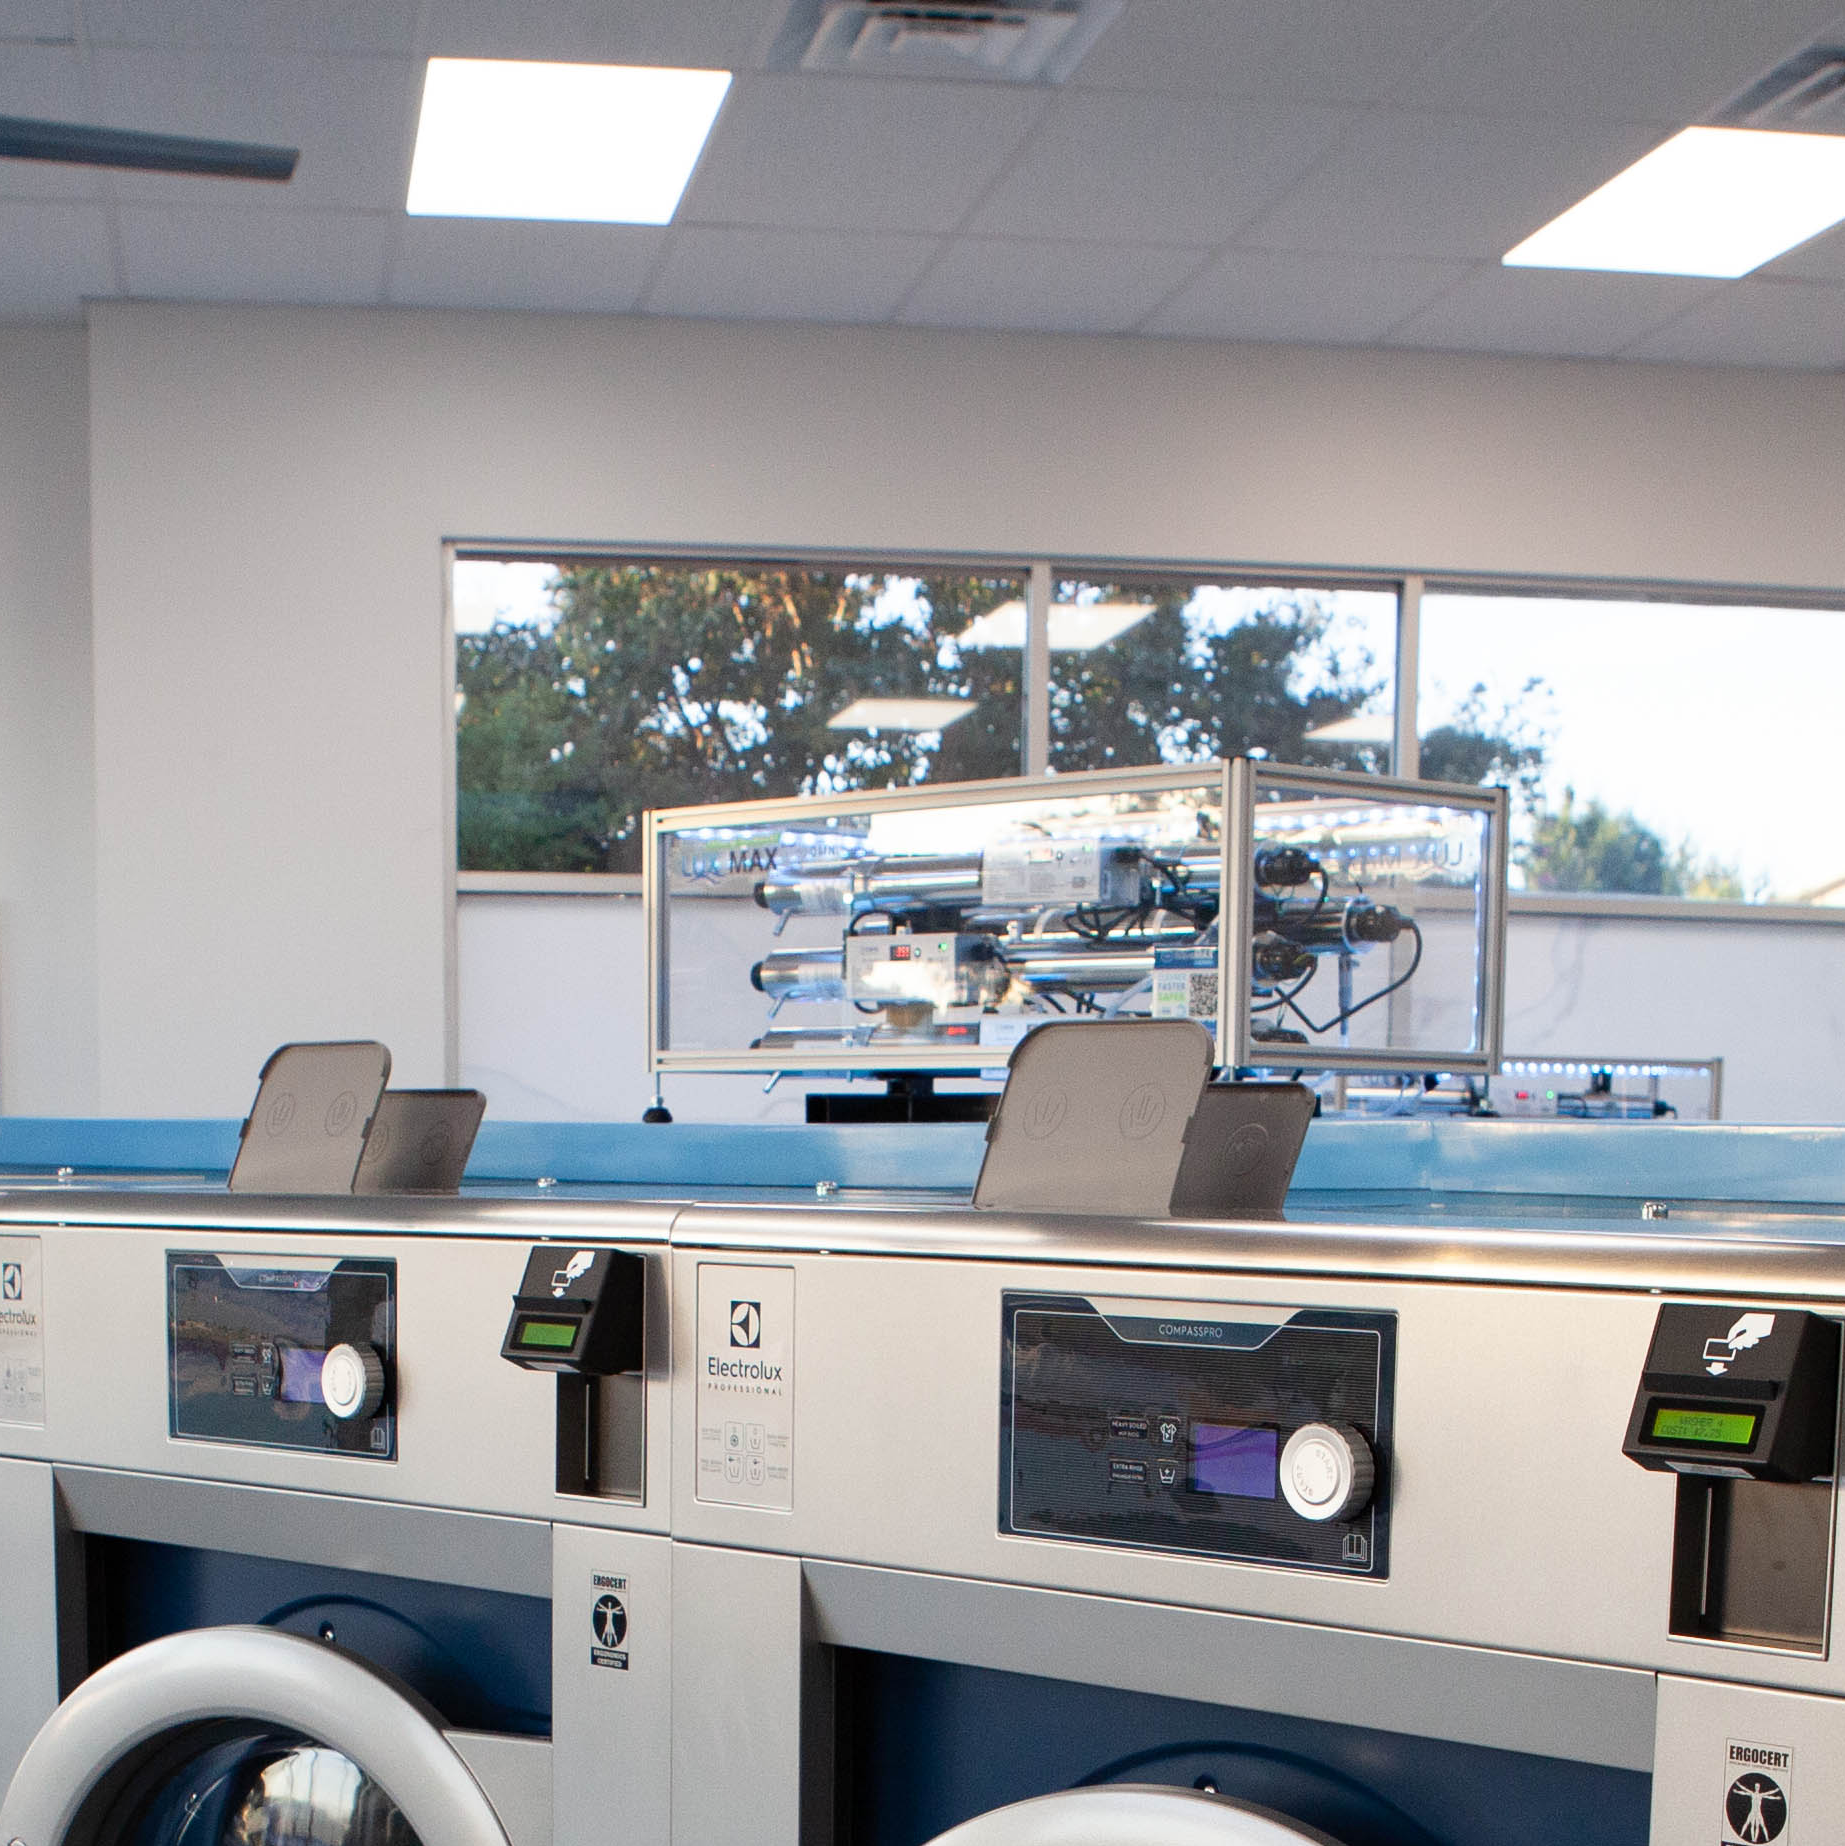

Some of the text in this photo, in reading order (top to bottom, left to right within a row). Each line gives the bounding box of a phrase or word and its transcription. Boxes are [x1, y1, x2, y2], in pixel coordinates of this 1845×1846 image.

[729, 848, 778, 873] MAX
[1158, 1324, 1223, 1338] COMPASSPRO
[707, 1356, 783, 1381] Electrolux
[707, 1382, 783, 1396] PROFESSIONAL
[593, 1574, 627, 1590] ERGOCERT
[1729, 1745, 1789, 1768] ERGOCERT
